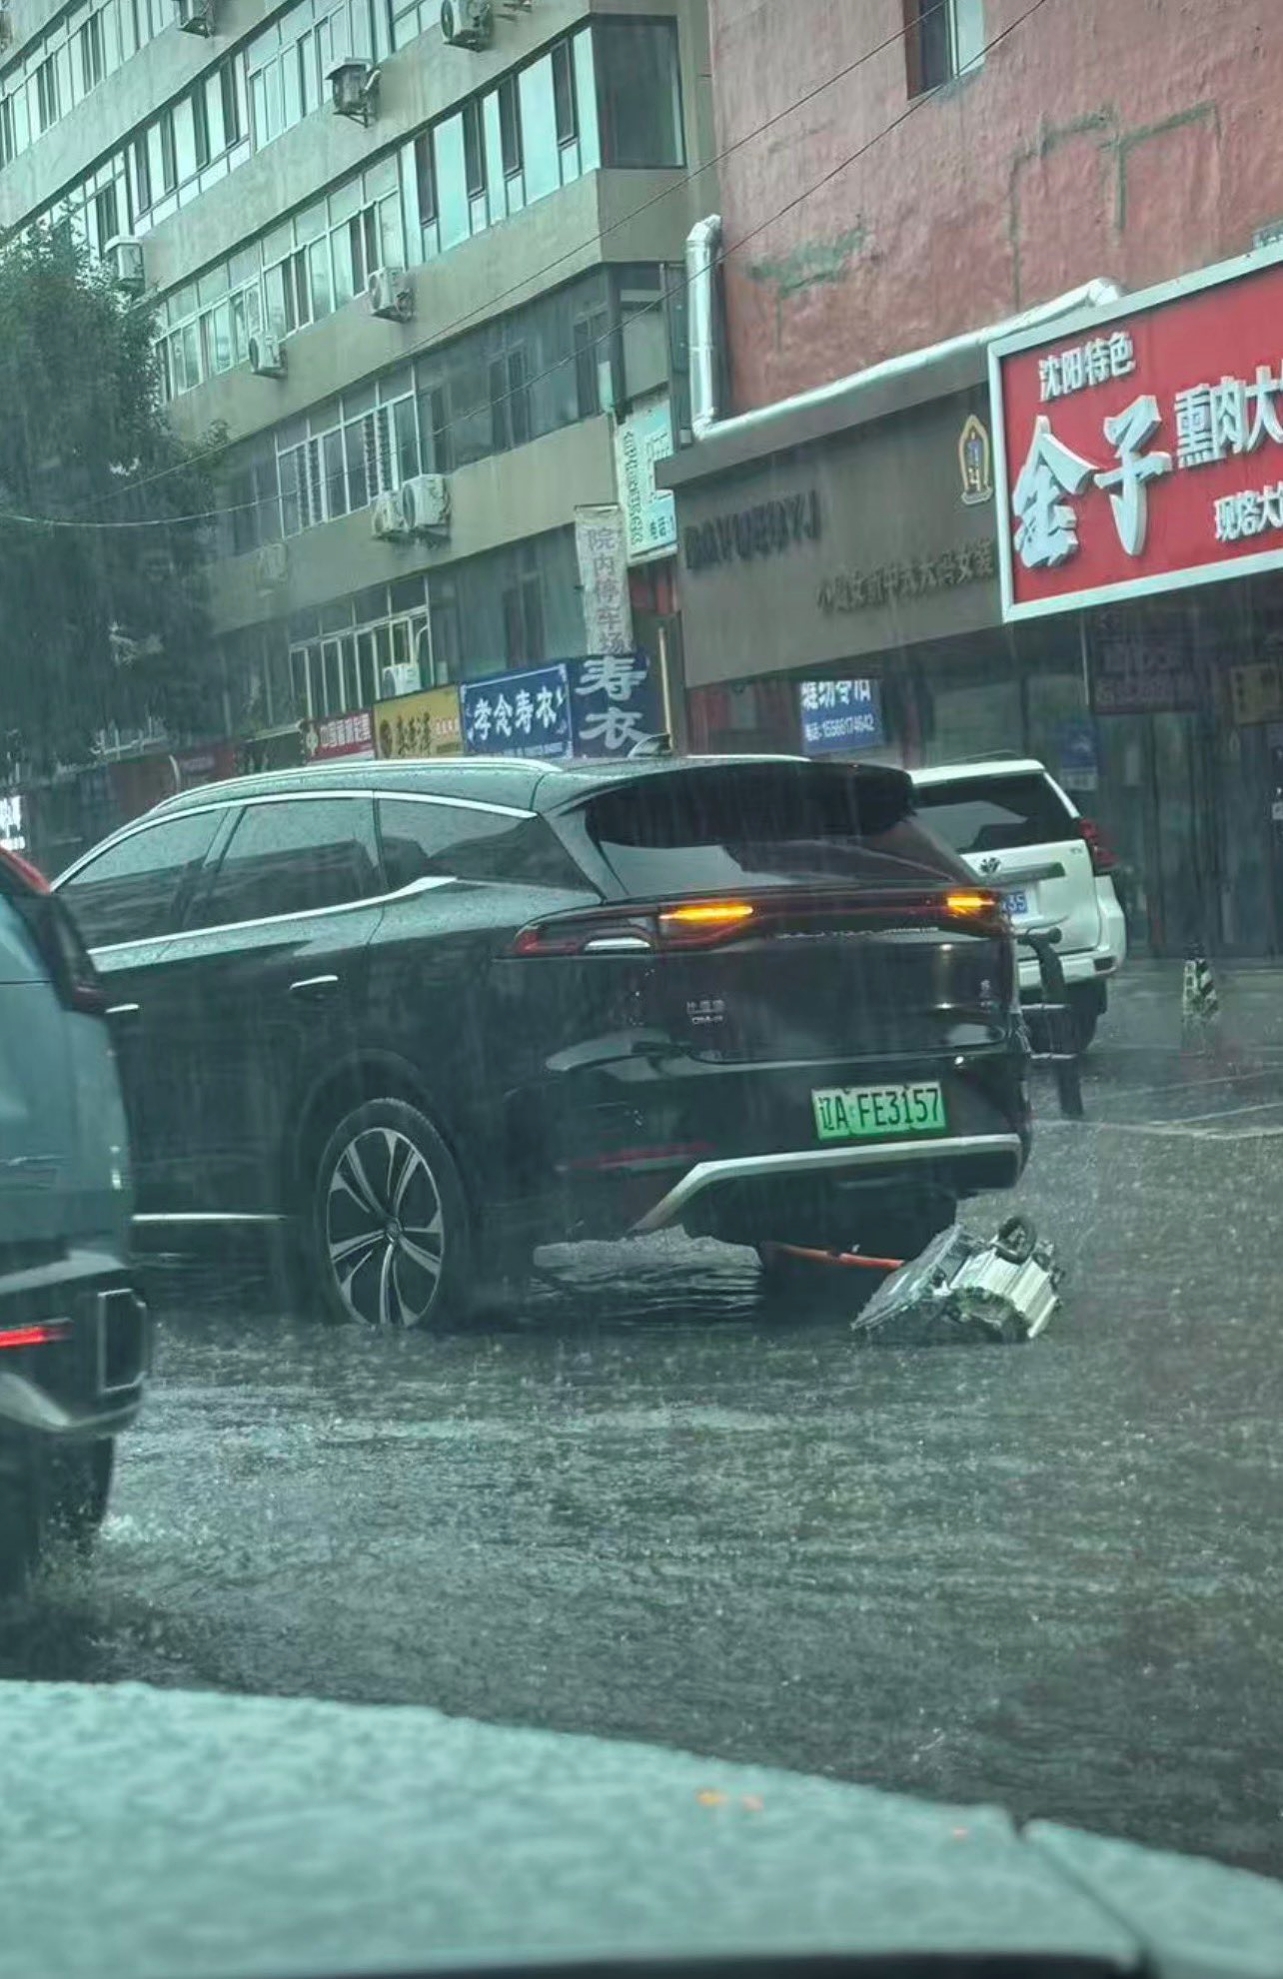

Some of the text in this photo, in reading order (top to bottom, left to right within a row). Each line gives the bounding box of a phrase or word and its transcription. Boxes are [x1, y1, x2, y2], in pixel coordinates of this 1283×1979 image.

[1038, 332, 1136, 401] 沈阳特色
[1012, 394, 1173, 569] 金子
[1174, 364, 1283, 468] 熏肉大
[1213, 480, 1283, 542] 现烙大
[586, 526, 625, 655] 院内停车场
[576, 656, 648, 751] 寿衣
[857, 1087, 939, 1129] FE3157
